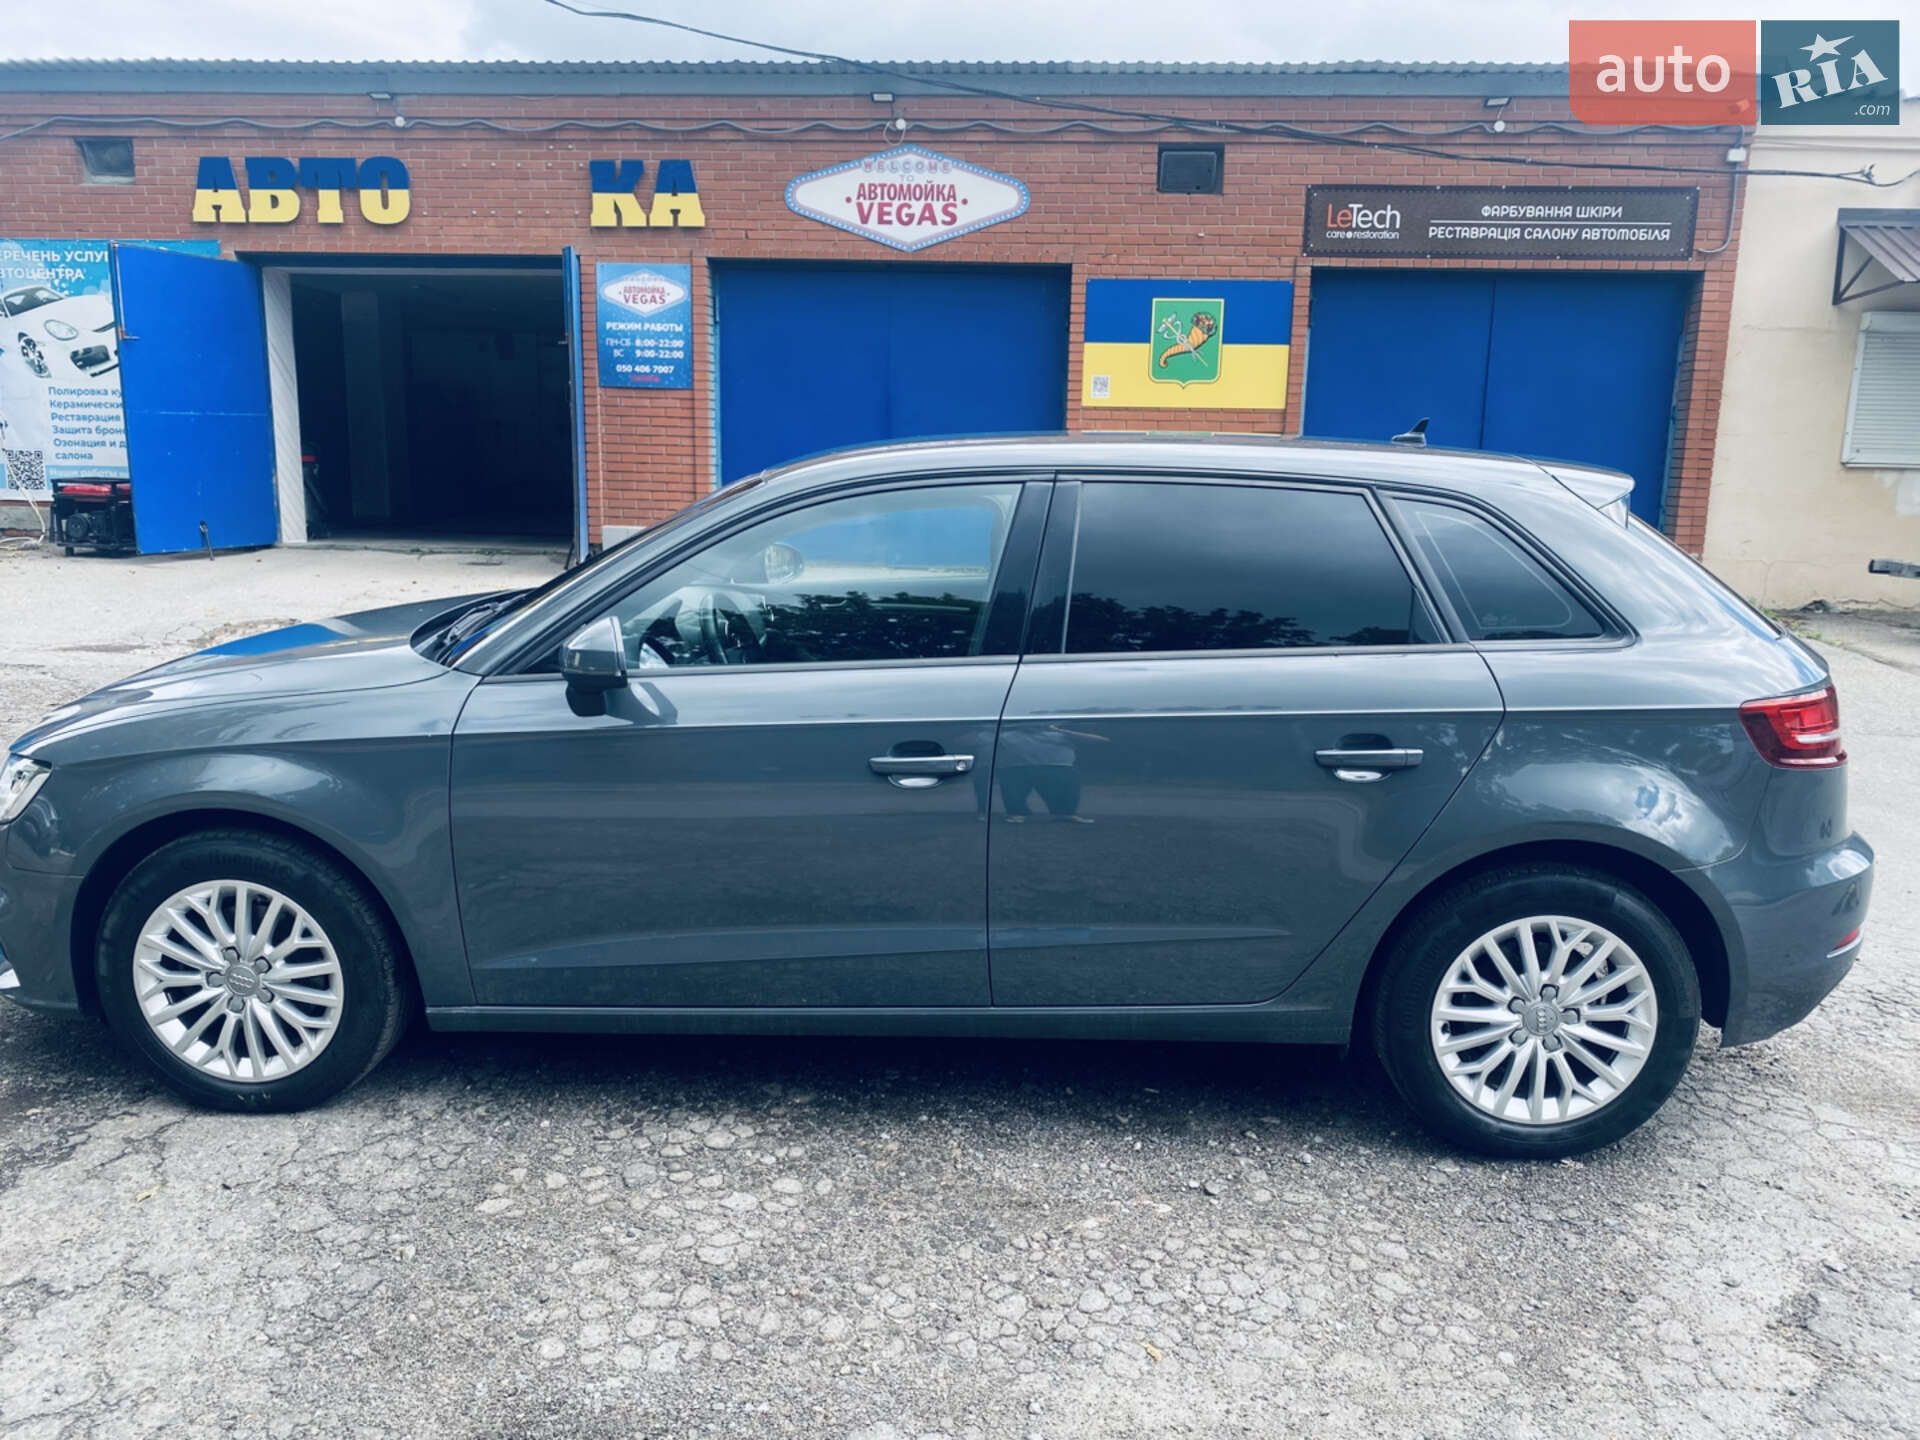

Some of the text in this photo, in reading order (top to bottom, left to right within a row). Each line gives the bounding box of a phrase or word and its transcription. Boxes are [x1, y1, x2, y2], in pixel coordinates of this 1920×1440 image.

[863, 160, 951, 174] WELCOME
[193, 156, 705, 228] АВТО КА
[856, 180, 957, 202] АВТОМОЙКА
[856, 202, 958, 226] VEGAS
[1327, 203, 1400, 229] LeTech
[1481, 205, 1623, 218] ФАРБУВАННЯ ШКІРИ
[1326, 230, 1400, 240] care restoration
[1428, 226, 1671, 241] РЕСТАВРАЦІЯ САЛОНУ АВТОМОБІЛЯ
[623, 294, 667, 305] VEGAS
[643, 322, 684, 332] РАБОТЫ
[48, 386, 108, 397] Полировка
[51, 412, 121, 423] Реставрация
[52, 424, 93, 435] Защита
[54, 438, 106, 448] Озонация
[55, 452, 93, 460] салона
